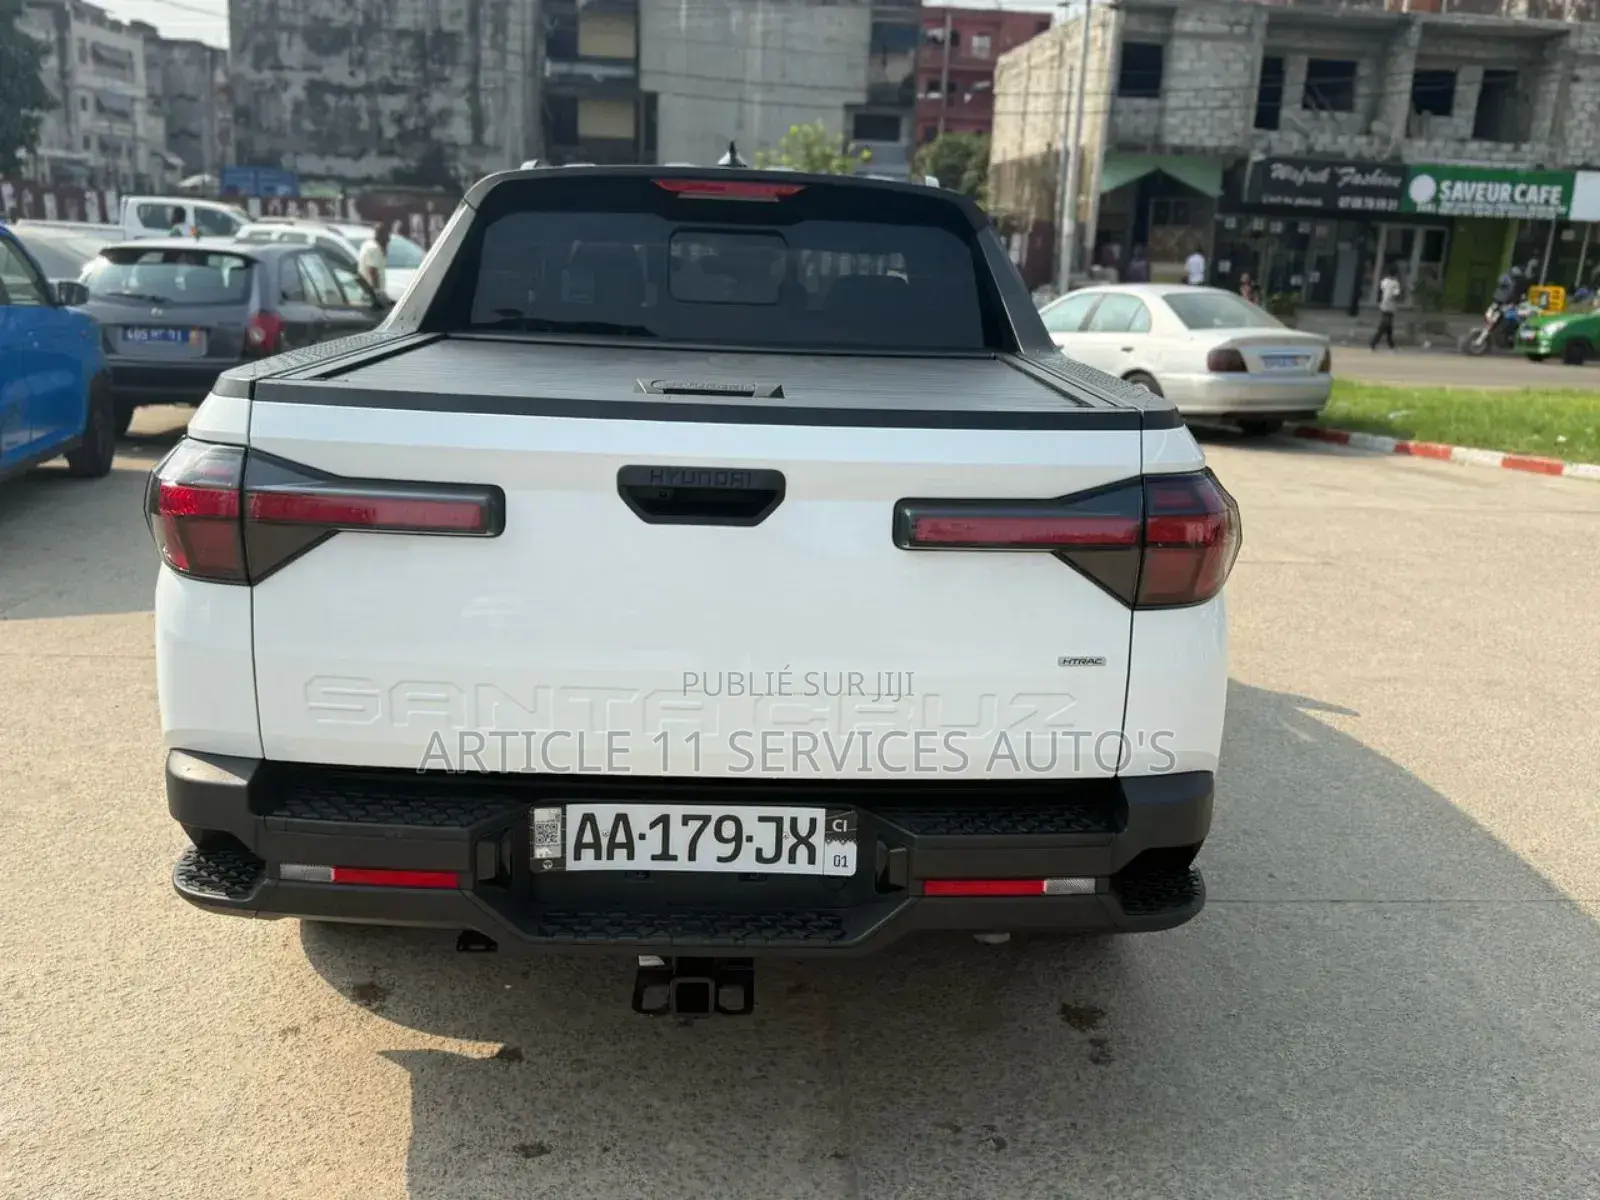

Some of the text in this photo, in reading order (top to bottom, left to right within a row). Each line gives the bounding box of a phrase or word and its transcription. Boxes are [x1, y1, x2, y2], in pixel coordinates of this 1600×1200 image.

[1439, 179, 1563, 205] SAVEUR CAFE
[650, 468, 752, 488] HYUNDAI
[1061, 656, 1104, 666] HTRAC
[304, 675, 1078, 739] SANTA CRUZ
[832, 819, 848, 832] CI
[833, 854, 849, 868] 01
